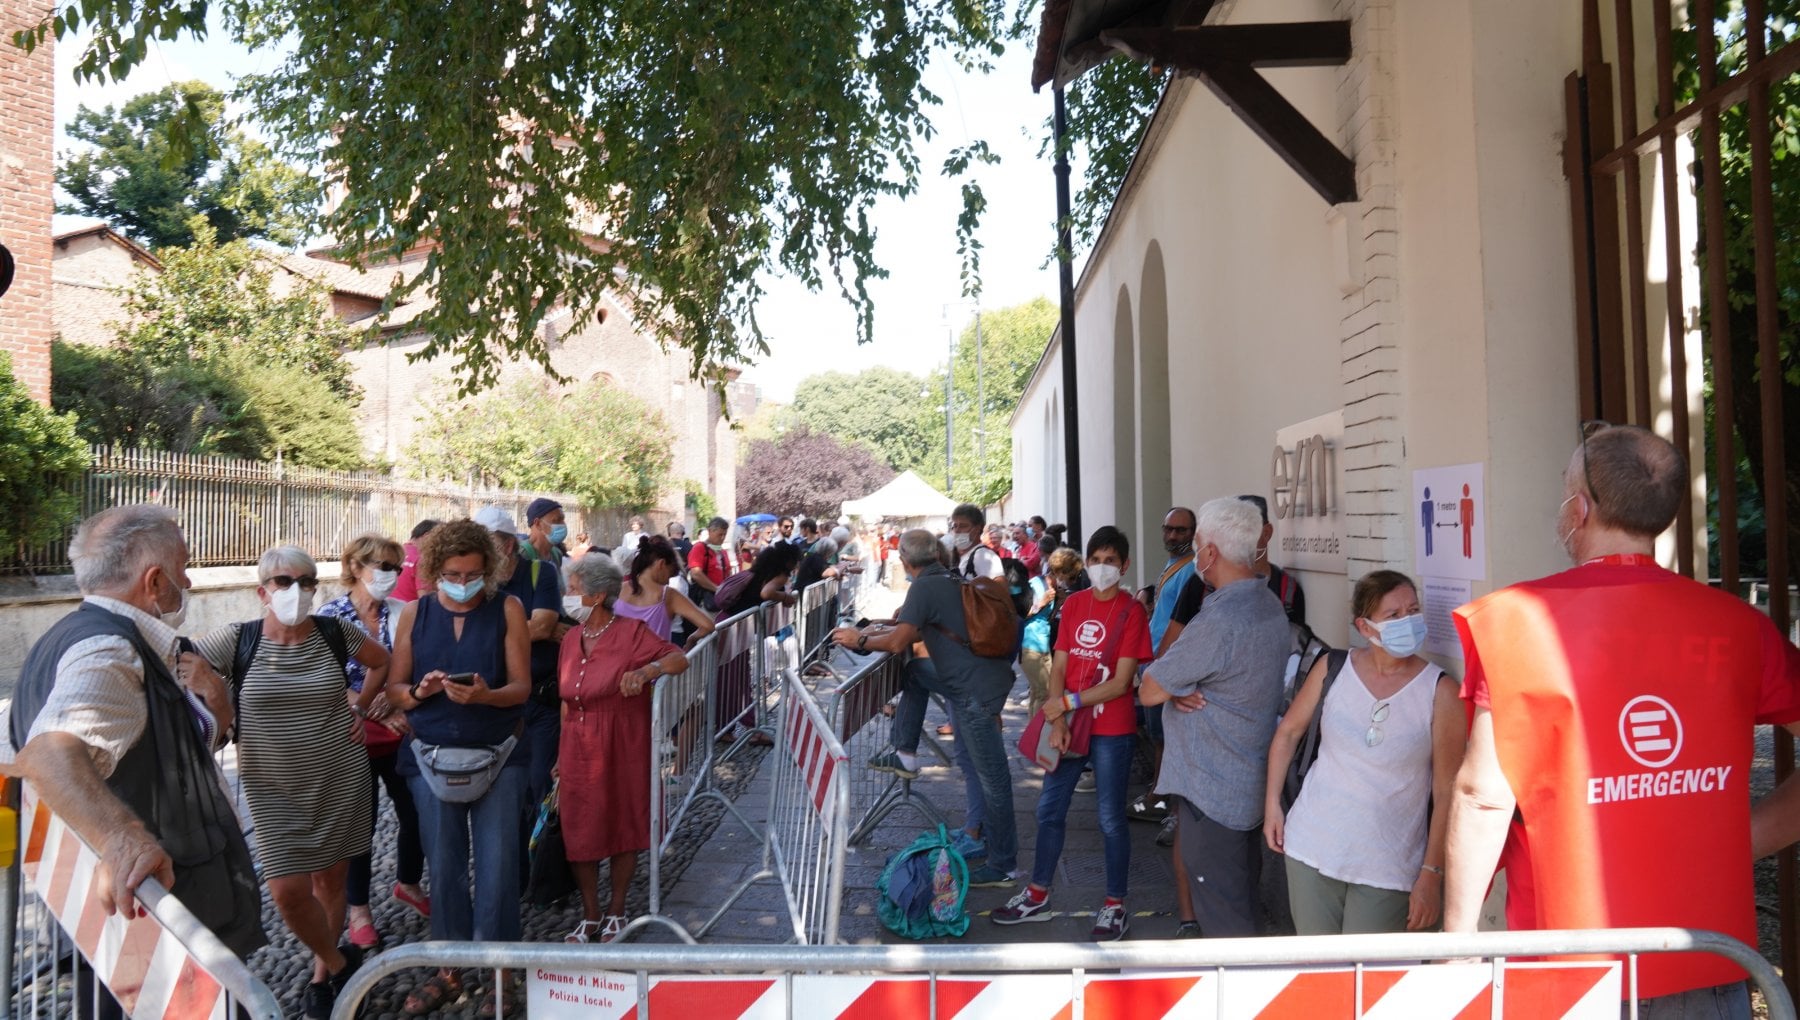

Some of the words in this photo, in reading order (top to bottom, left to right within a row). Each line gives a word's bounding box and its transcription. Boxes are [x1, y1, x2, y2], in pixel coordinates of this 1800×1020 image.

[1441, 502, 1457, 511] metro
[1586, 765, 1733, 805] EMERGENCY
[537, 968, 574, 985] Comune
[578, 974, 587, 987] di
[592, 976, 625, 992] Milano
[549, 989, 579, 1003] Polizia
[584, 994, 613, 1008] Locale
